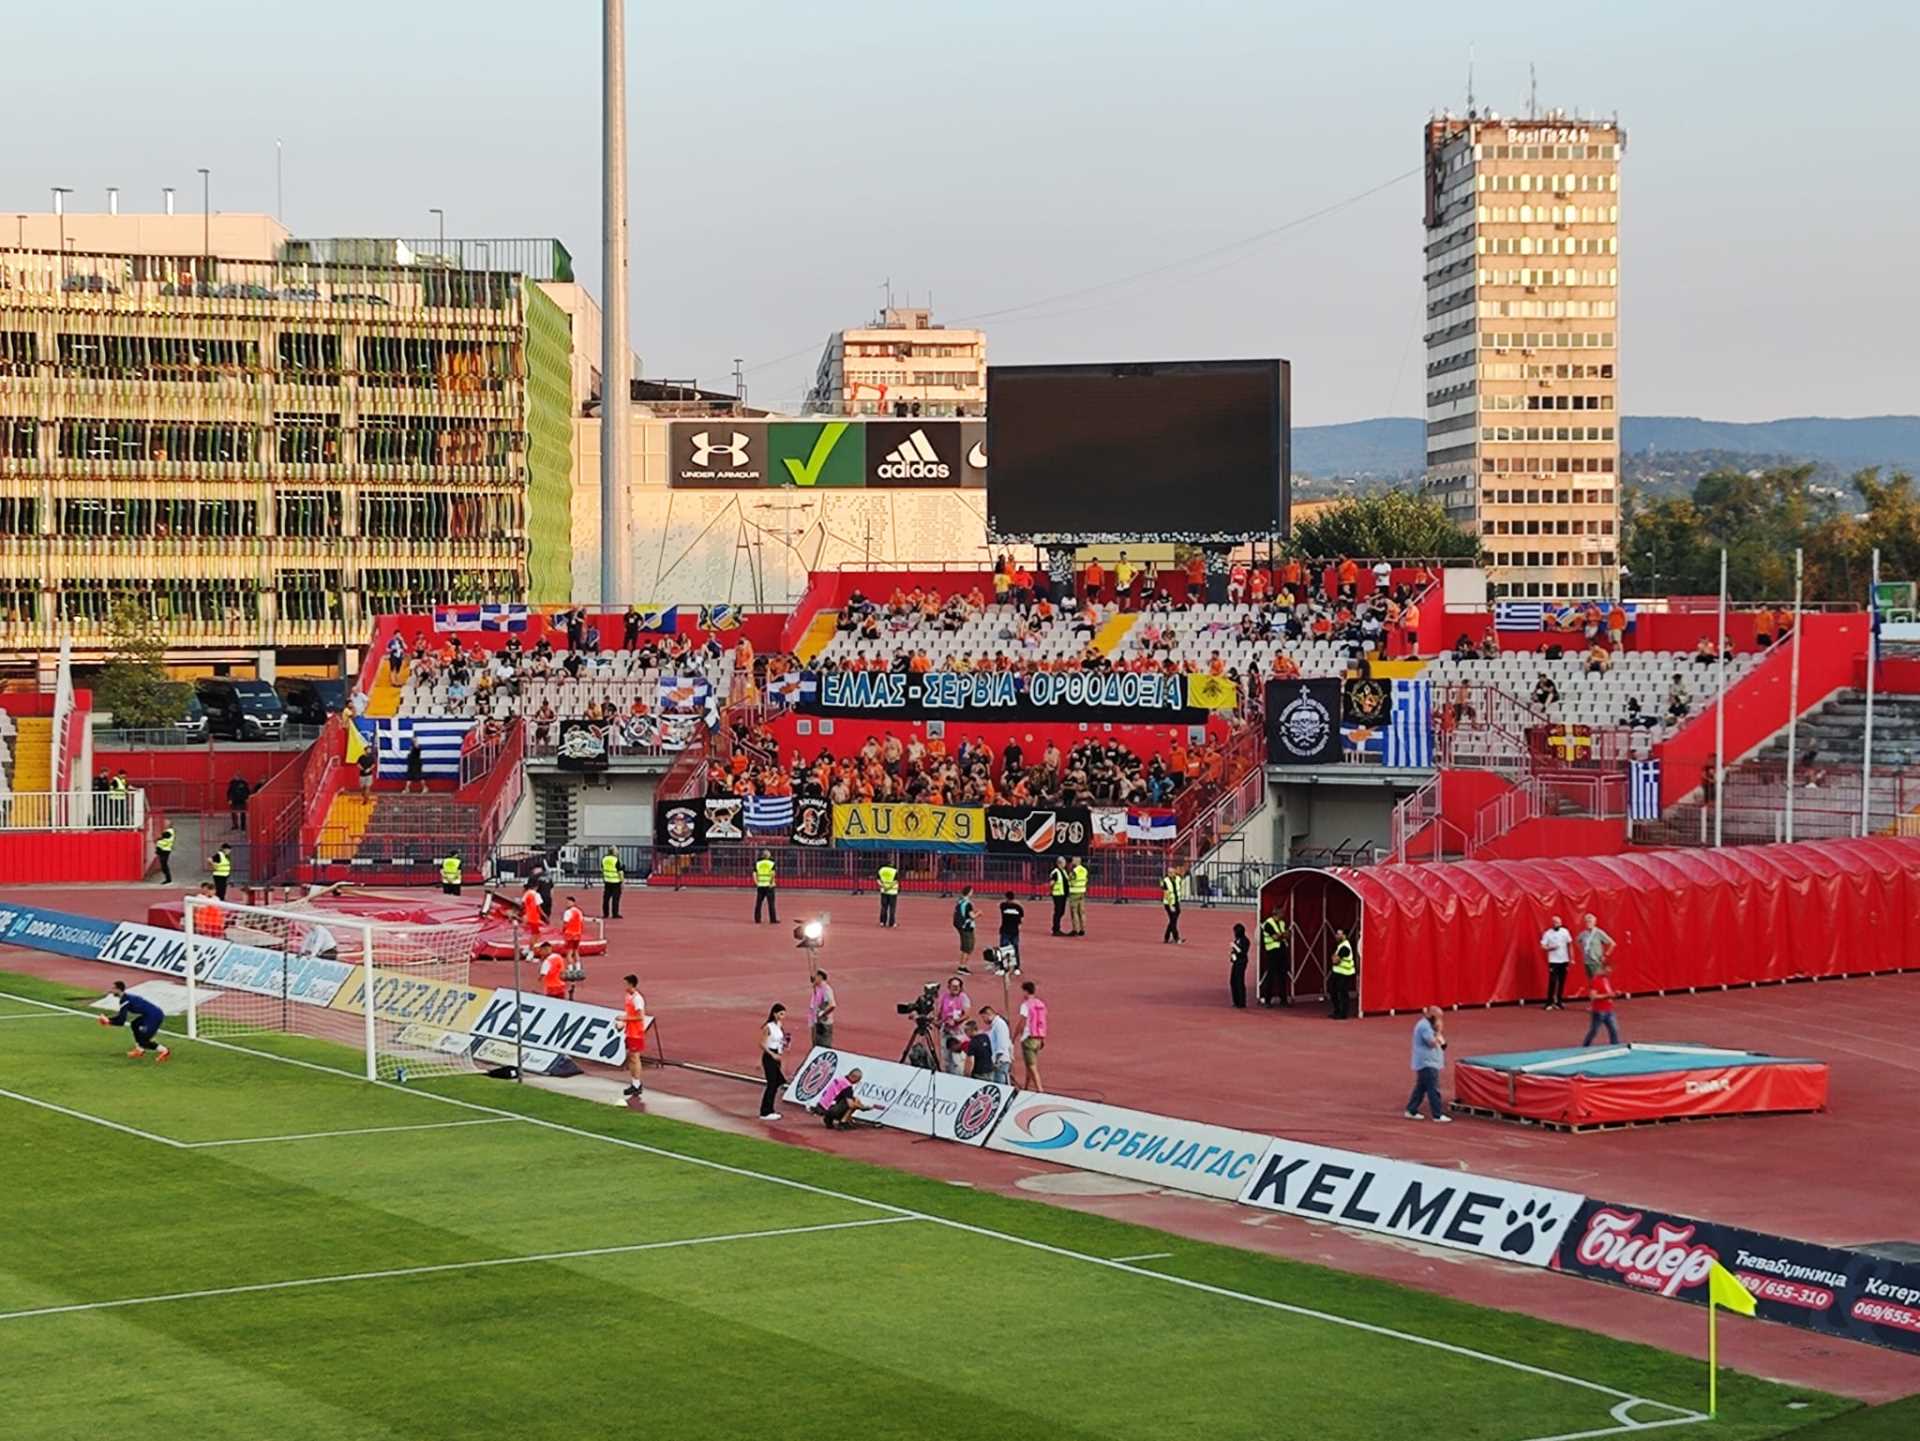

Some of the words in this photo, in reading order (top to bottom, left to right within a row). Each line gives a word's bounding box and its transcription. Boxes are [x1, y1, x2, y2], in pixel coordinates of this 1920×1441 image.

[681, 471, 716, 479] UNDER
[717, 471, 760, 479] ARMOUR
[877, 460, 950, 479] adidas
[1030, 672, 1182, 710] ΟΡΘΟΔΟΞΙΑ
[931, 810, 971, 840] 79
[347, 976, 477, 1027] MOZZART
[475, 999, 611, 1055] KELME
[854, 1081, 897, 1104] RESSO
[1083, 1124, 1256, 1180] СРБИЈАГАС
[1248, 1153, 1504, 1246] KELME
[1864, 1277, 1920, 1306] Кетер
